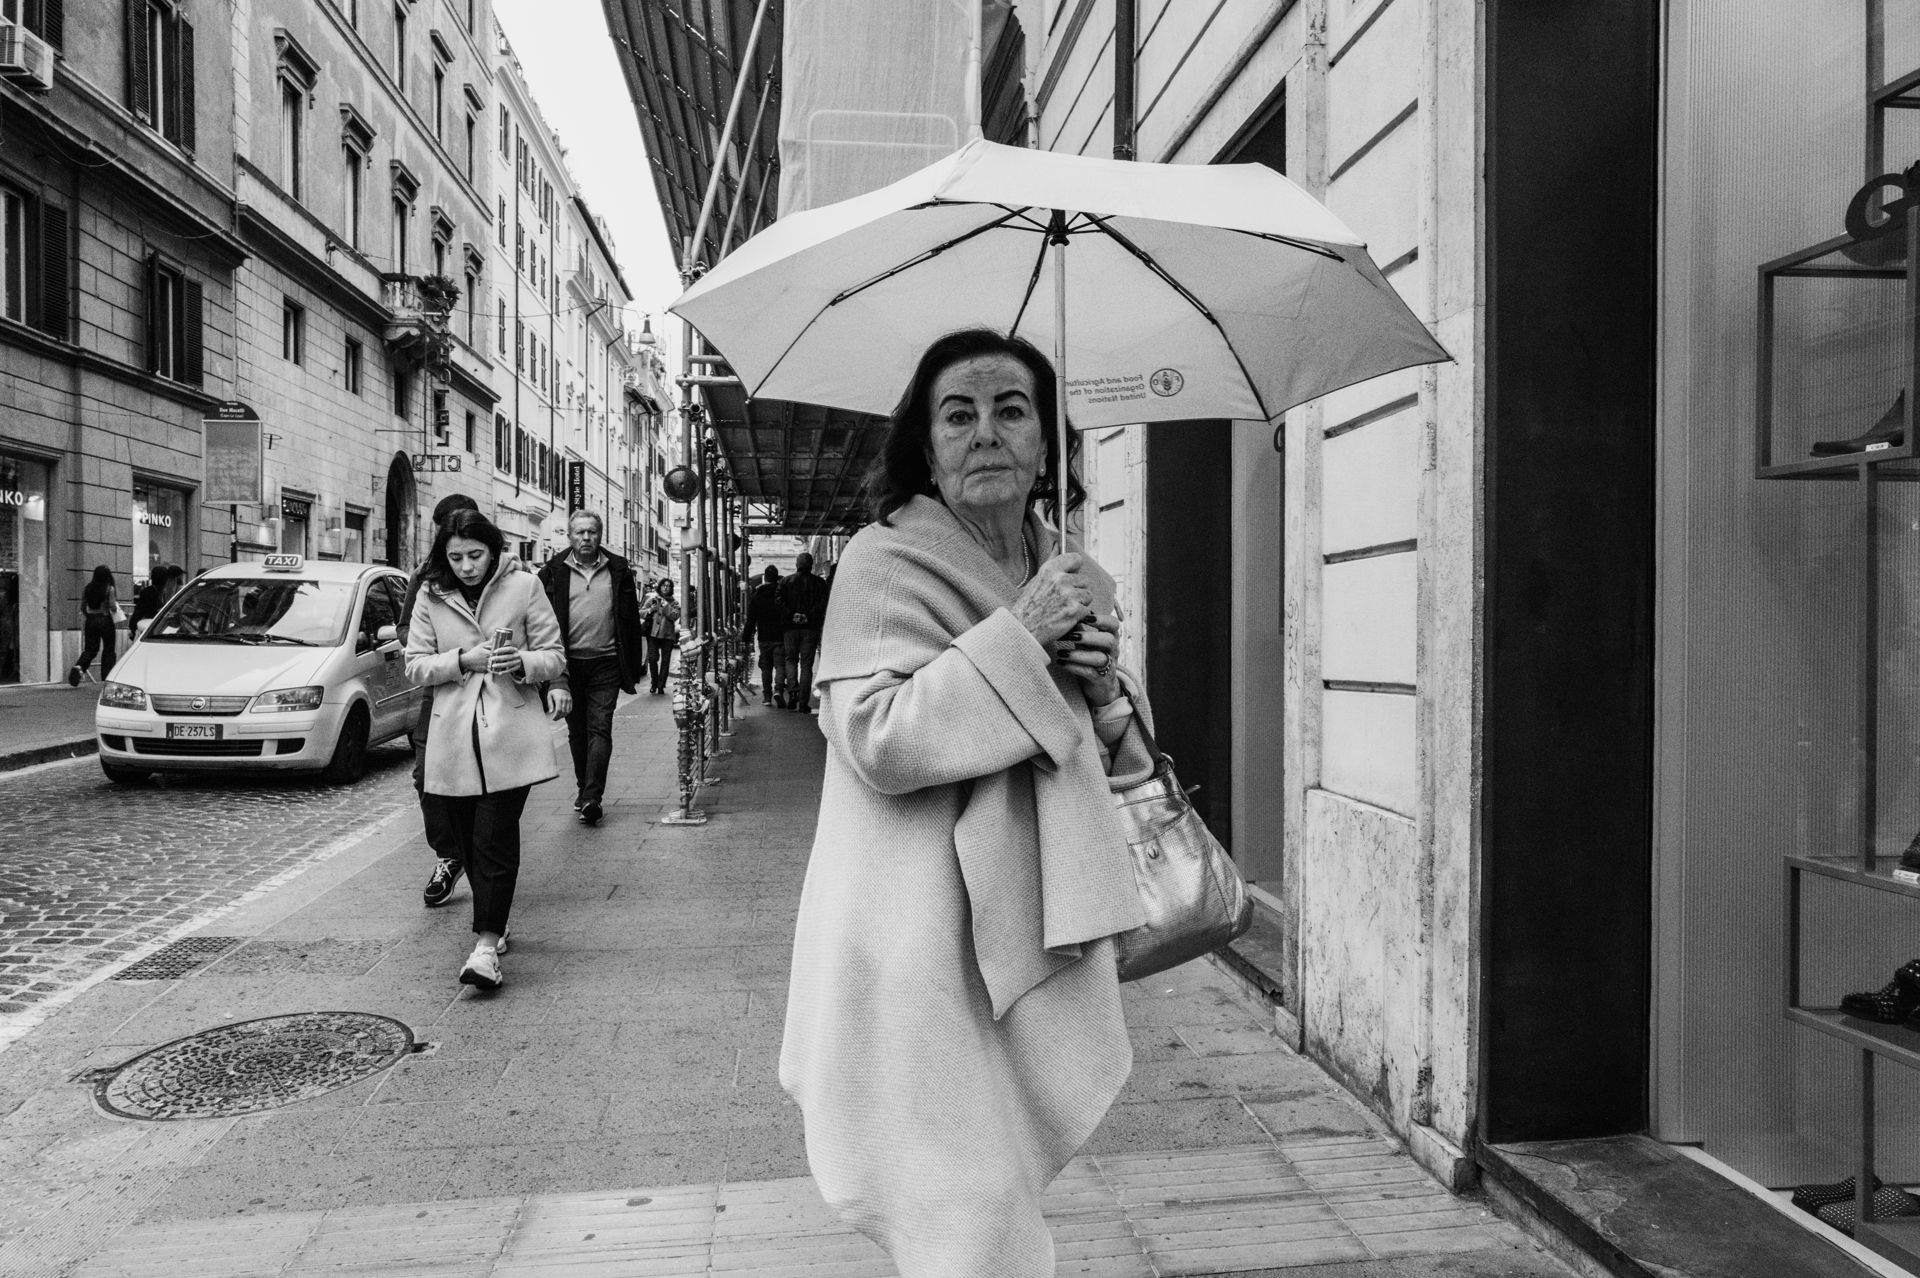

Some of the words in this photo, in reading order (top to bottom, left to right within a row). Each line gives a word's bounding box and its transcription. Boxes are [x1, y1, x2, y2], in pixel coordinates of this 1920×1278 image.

[573, 466, 581, 485] Hotel
[573, 486, 582, 505] Style
[142, 512, 171, 527] PINKO
[268, 556, 297, 565] TAXI
[174, 725, 185, 737] DE
[187, 726, 215, 737] 237LS
